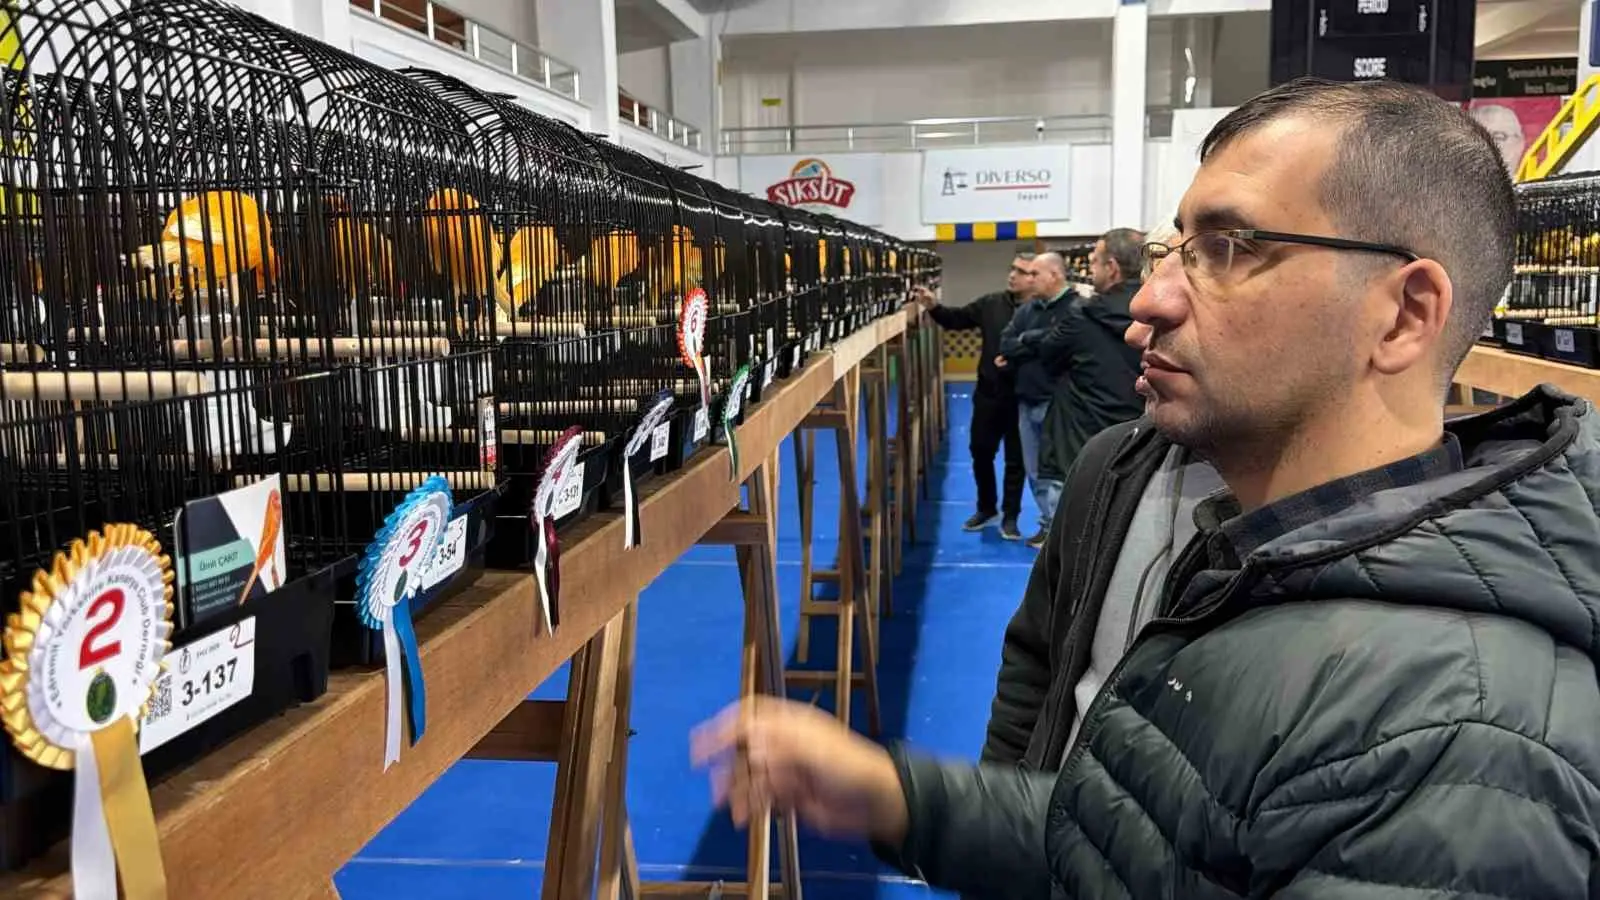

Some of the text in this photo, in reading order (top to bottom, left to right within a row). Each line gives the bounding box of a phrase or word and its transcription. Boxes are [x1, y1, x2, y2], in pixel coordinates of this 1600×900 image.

[1353, 57, 1387, 78] SCORE
[975, 168, 1051, 185] DIVERSO
[689, 309, 698, 333] 6
[456, 518, 465, 542] 3
[398, 519, 428, 568] 3
[438, 540, 457, 565] 3-54
[78, 586, 125, 671] 2
[229, 623, 253, 650] 2
[181, 657, 238, 707] 3-137
